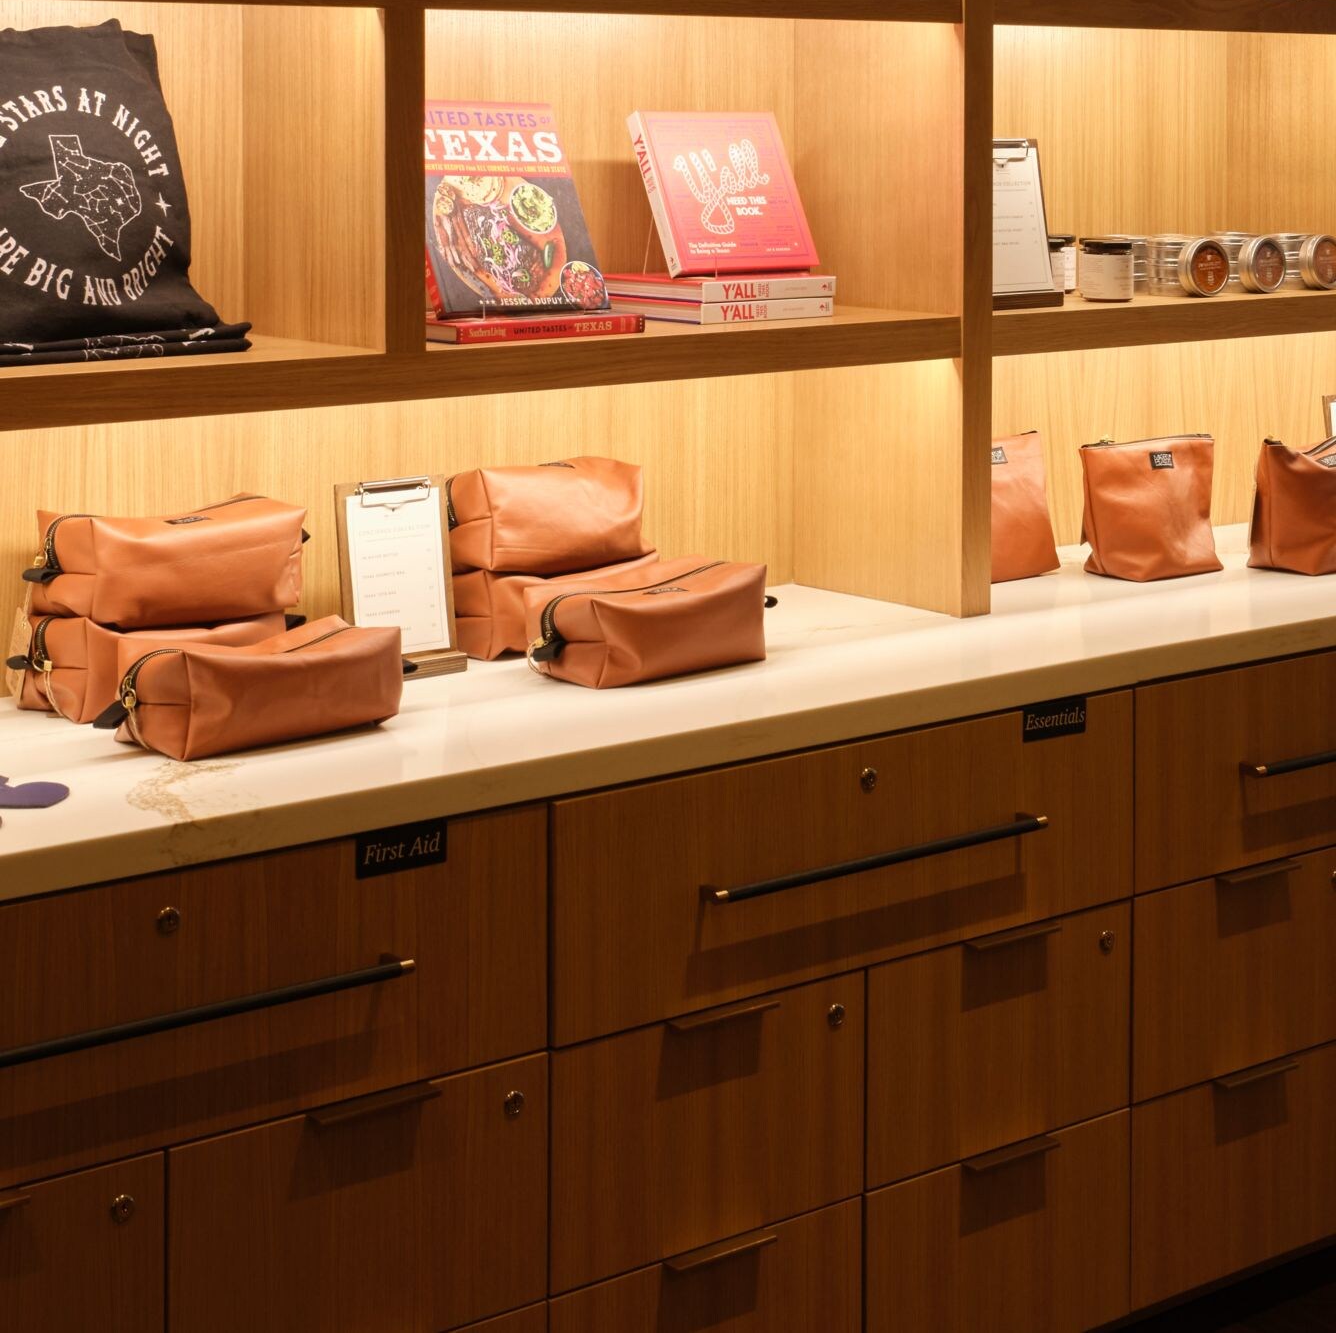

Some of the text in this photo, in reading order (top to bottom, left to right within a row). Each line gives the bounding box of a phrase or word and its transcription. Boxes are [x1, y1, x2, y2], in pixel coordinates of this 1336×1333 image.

[426, 111, 471, 126] ITED
[473, 112, 537, 128] TASTES
[0, 85, 170, 177] STARS AT NIGHT
[633, 133, 651, 179] Y'ALL
[726, 195, 767, 205] NEED THIS
[24, 257, 74, 300] BIG
[83, 275, 122, 306] AND
[122, 225, 174, 302] BRIGHT
[722, 283, 756, 299] Y'ALL
[500, 296, 562, 306] JESSICA DUPUY
[721, 304, 754, 321] Y'ALL
[574, 320, 613, 333] TEXAS
[1025, 706, 1085, 731] Essentials
[363, 831, 441, 865] First Aid
